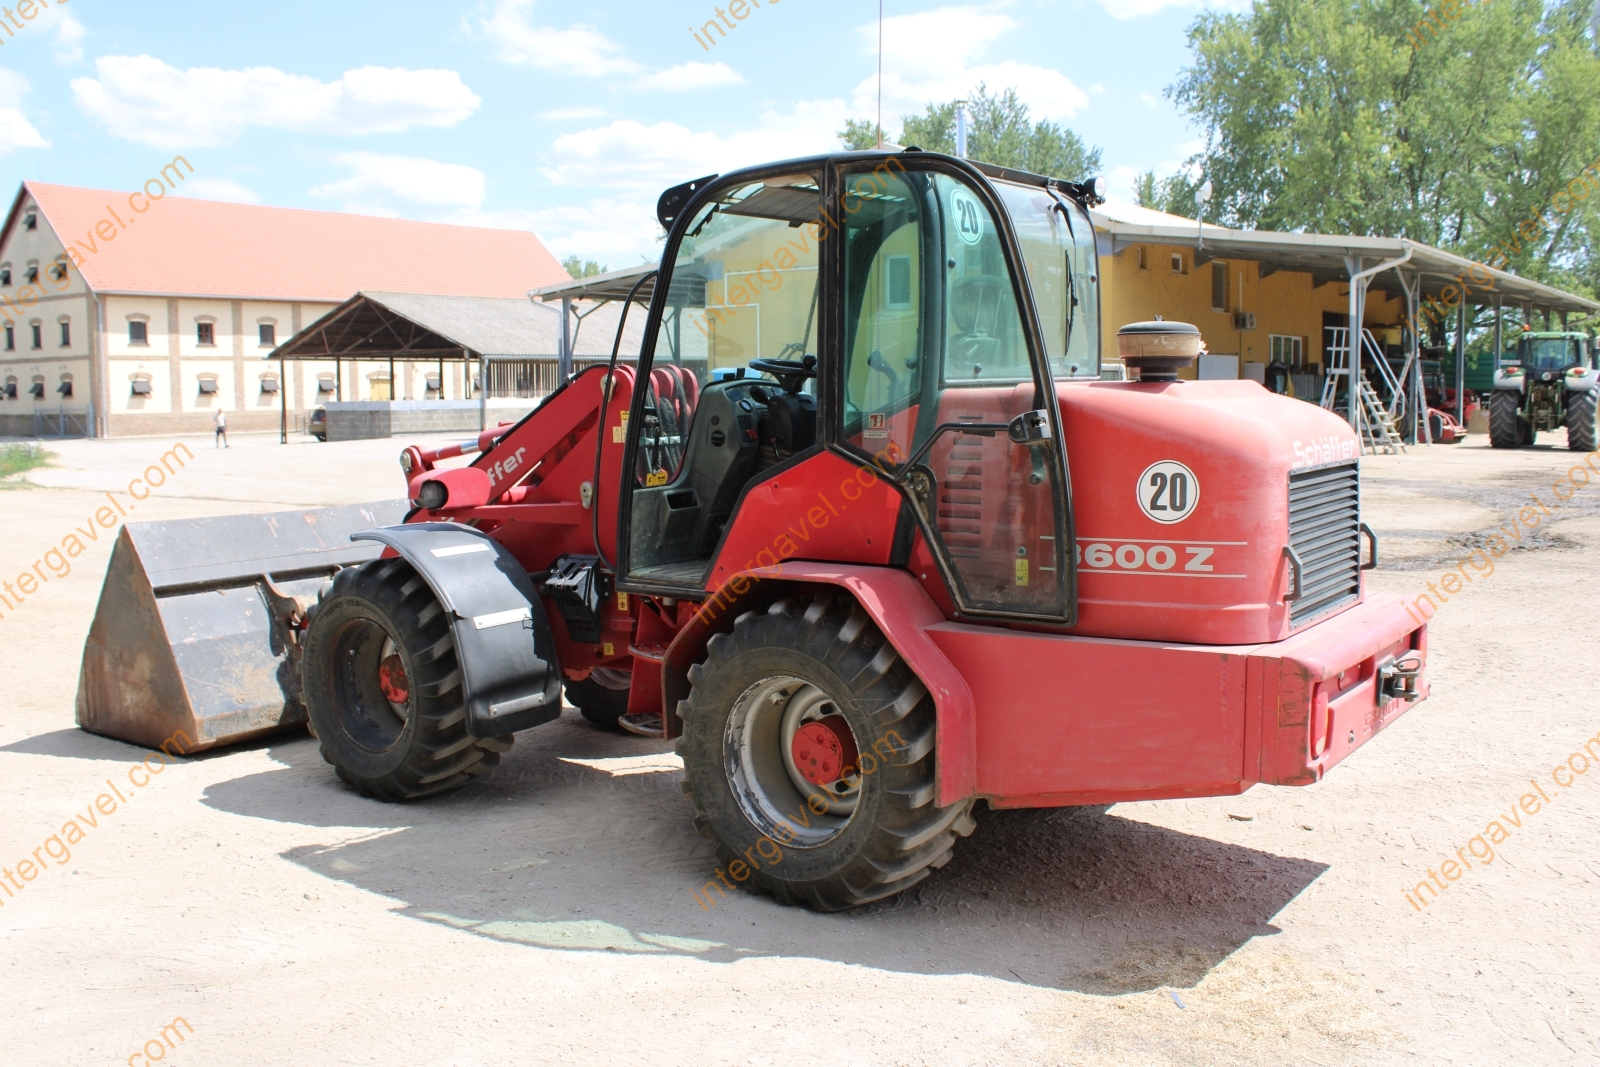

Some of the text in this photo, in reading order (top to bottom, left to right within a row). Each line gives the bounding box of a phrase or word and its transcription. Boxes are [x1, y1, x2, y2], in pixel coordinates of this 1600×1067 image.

[956, 198, 979, 235] 20
[1291, 435, 1357, 469] Schäffer
[1149, 472, 1188, 512] 20
[1184, 546, 1215, 572] Z
